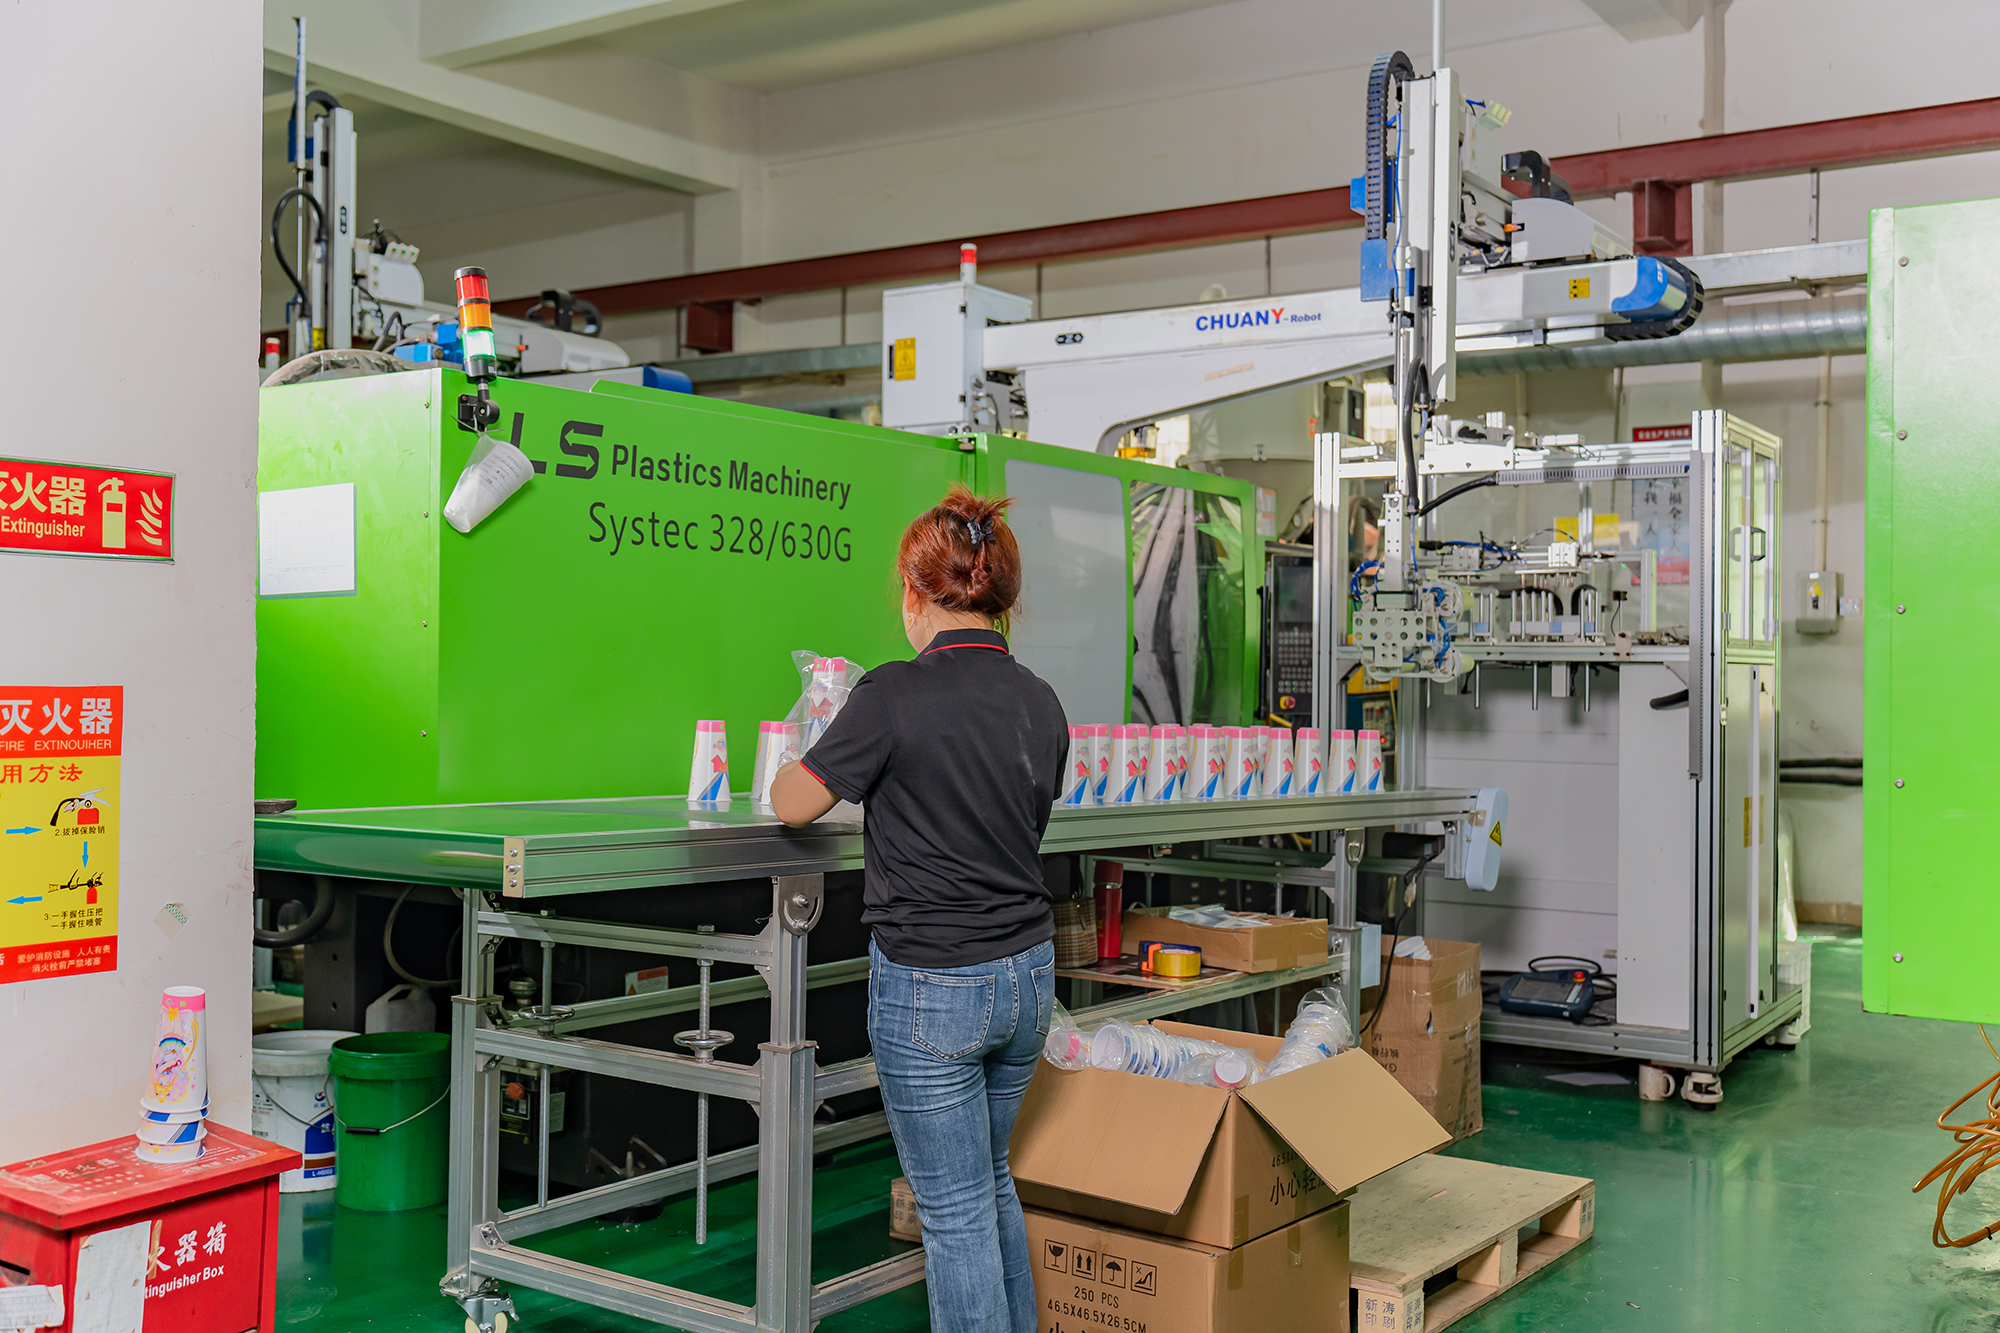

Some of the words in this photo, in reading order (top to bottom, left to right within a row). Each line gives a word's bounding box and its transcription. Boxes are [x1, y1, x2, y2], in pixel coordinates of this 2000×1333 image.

[0, 471, 87, 517] 火器
[612, 444, 722, 488] Plastics
[728, 460, 852, 510] Machinery
[1, 516, 86, 539] Extinguisher
[588, 502, 699, 556] Systec
[709, 513, 852, 563] 328/630G
[0, 698, 114, 736] 灭火器
[0, 740, 25, 751] FIRE
[202, 1265, 225, 1281] Box
[1074, 1285, 1094, 1302] 250
[1101, 1291, 1119, 1309] PCS
[1047, 1298, 1147, 1333] 46.5X46.5X26.5CM
